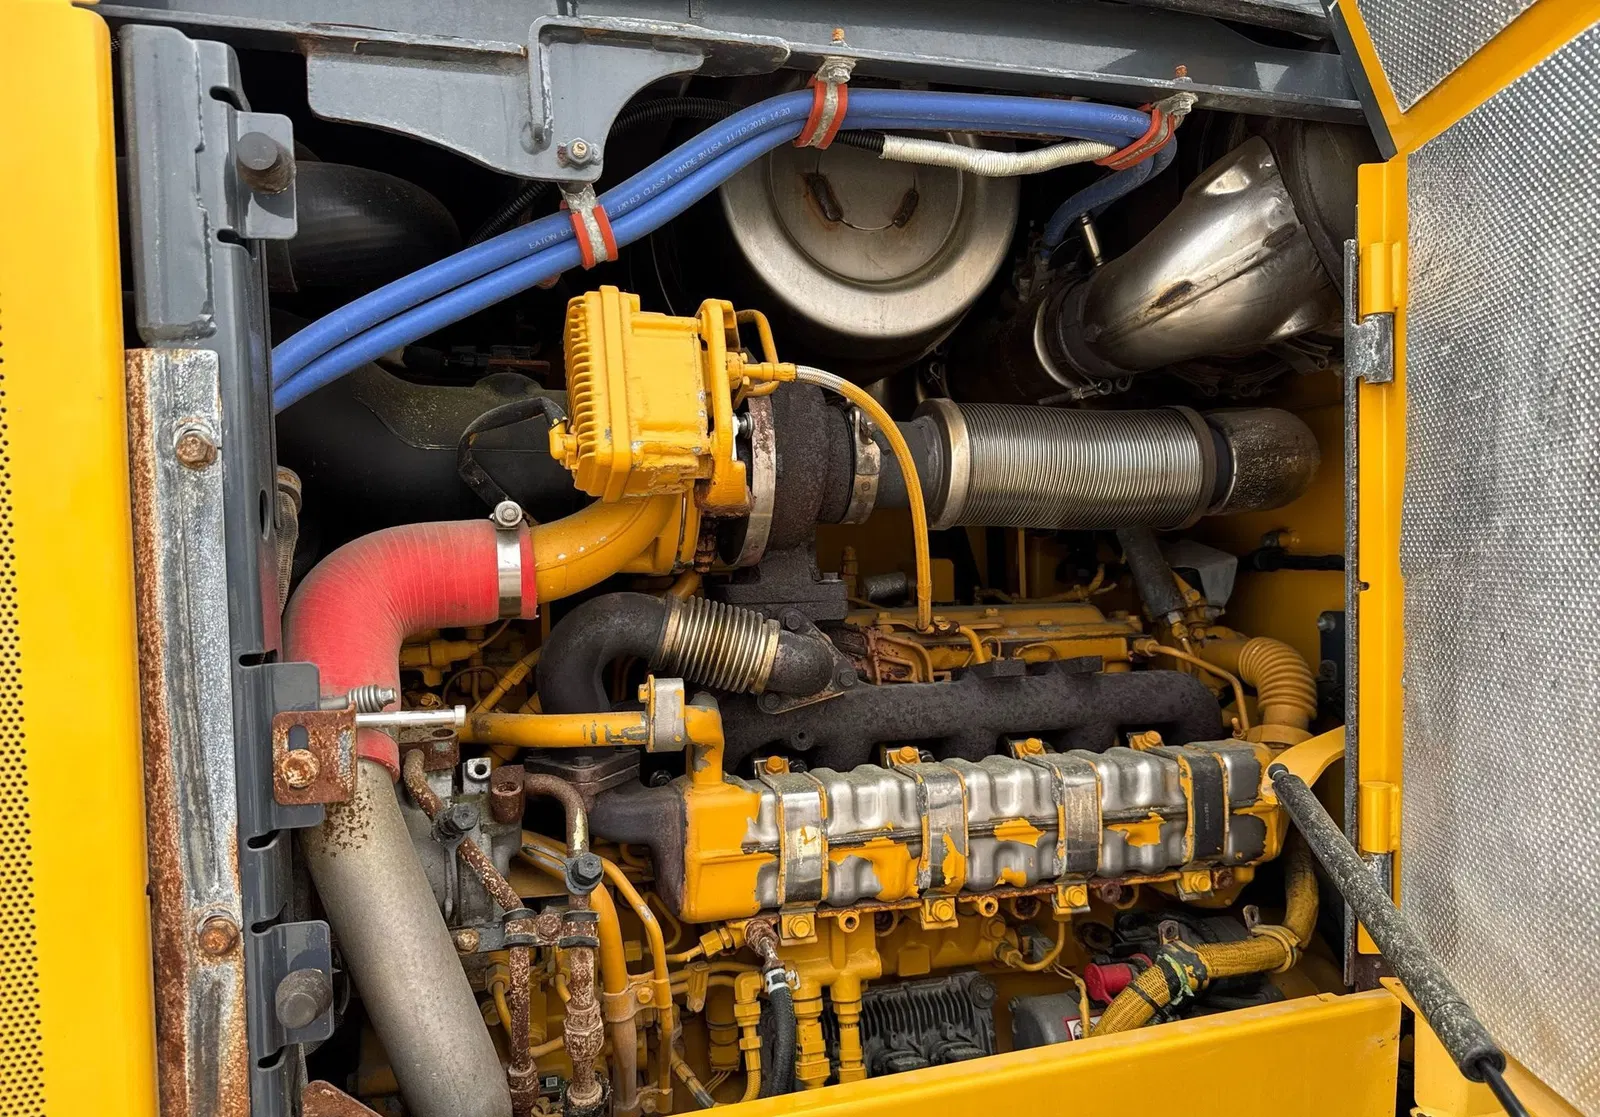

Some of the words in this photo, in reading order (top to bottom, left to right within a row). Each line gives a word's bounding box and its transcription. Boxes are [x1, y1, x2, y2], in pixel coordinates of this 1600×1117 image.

[643, 177, 666, 195] CLASS
[675, 157, 697, 173] MADE
[707, 141, 723, 155] USA
[529, 234, 557, 249] EATON
